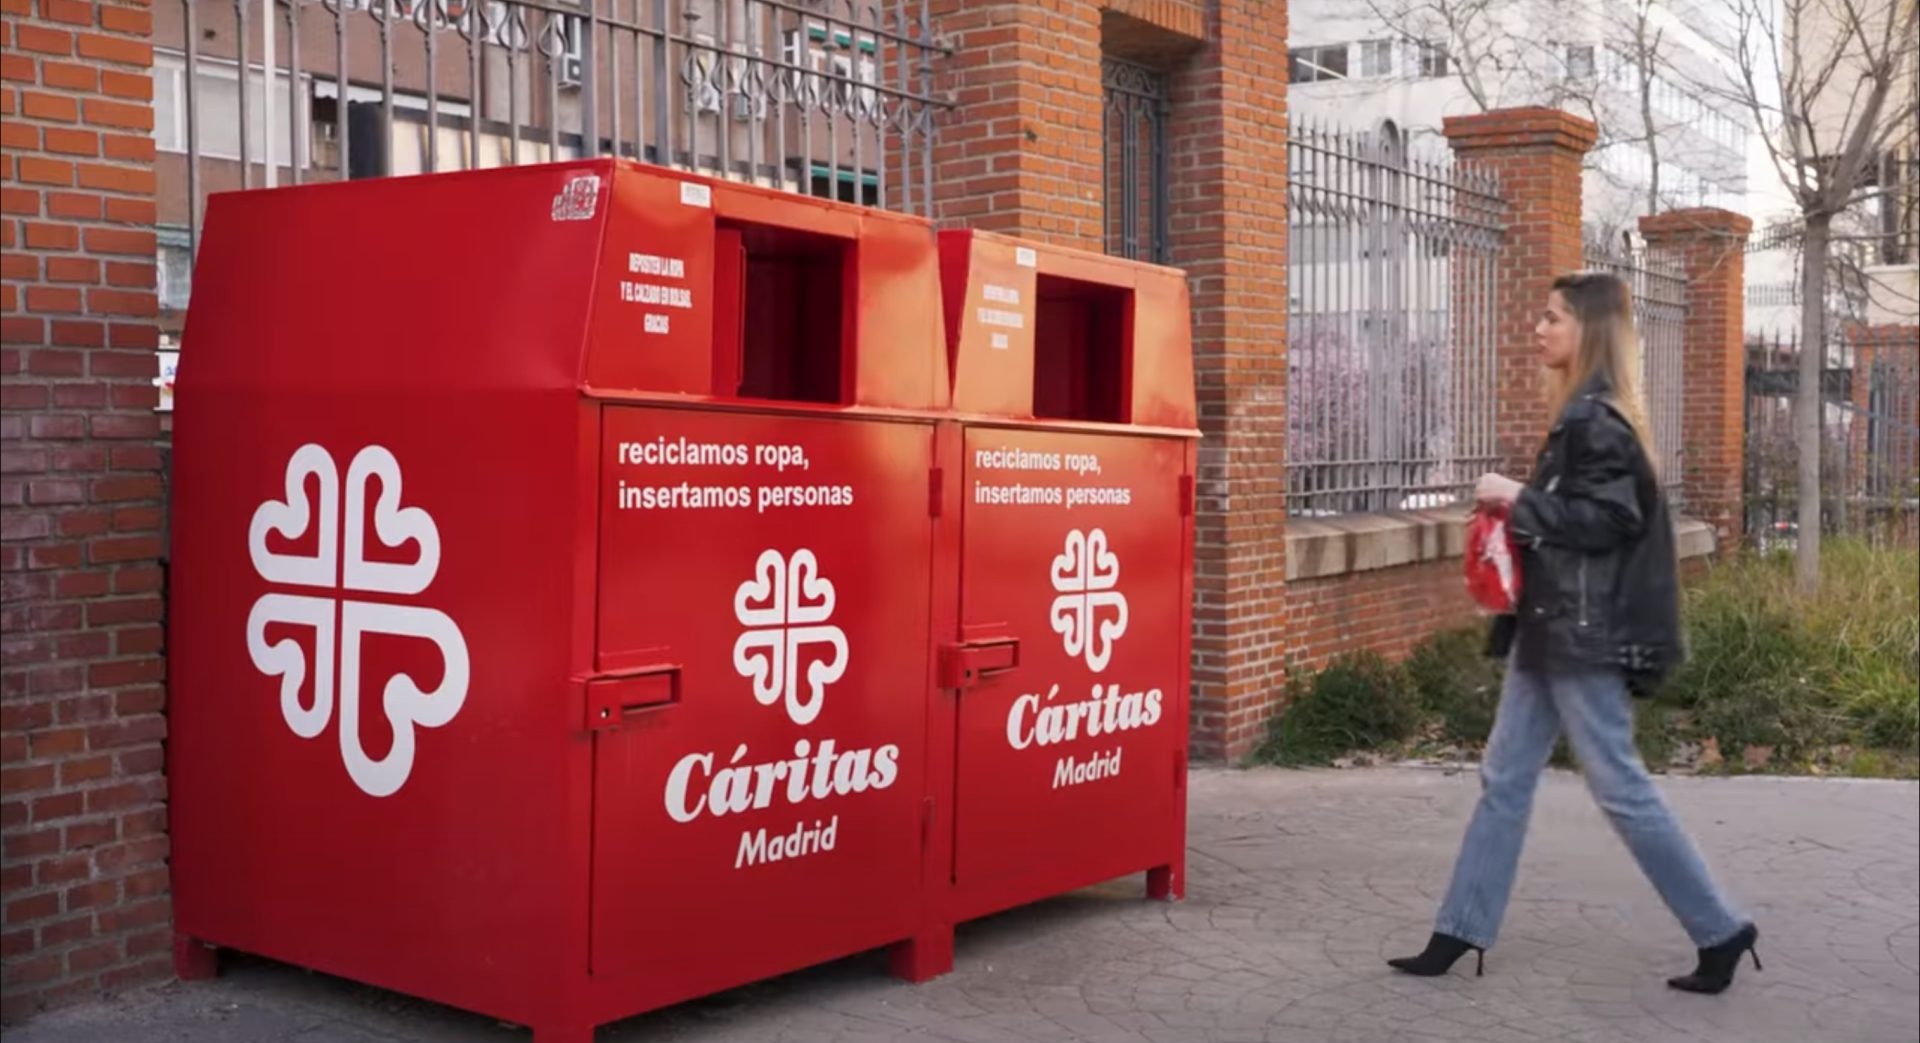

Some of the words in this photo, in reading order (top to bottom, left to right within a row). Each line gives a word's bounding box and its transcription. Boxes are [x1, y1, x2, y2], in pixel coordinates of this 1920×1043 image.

[619, 436, 749, 465] reciclamos
[755, 444, 810, 472] ropa,
[975, 446, 1062, 471] reciclamos
[1064, 453, 1102, 476] ropa,
[619, 480, 751, 509] insertamos
[758, 482, 854, 512] personas
[975, 480, 1063, 505] insertamos
[1066, 485, 1132, 509] personas
[1006, 683, 1163, 750] Cáritas
[664, 738, 900, 823] Cáritas
[1052, 746, 1122, 789] Madrid
[734, 815, 839, 869] Madrid
